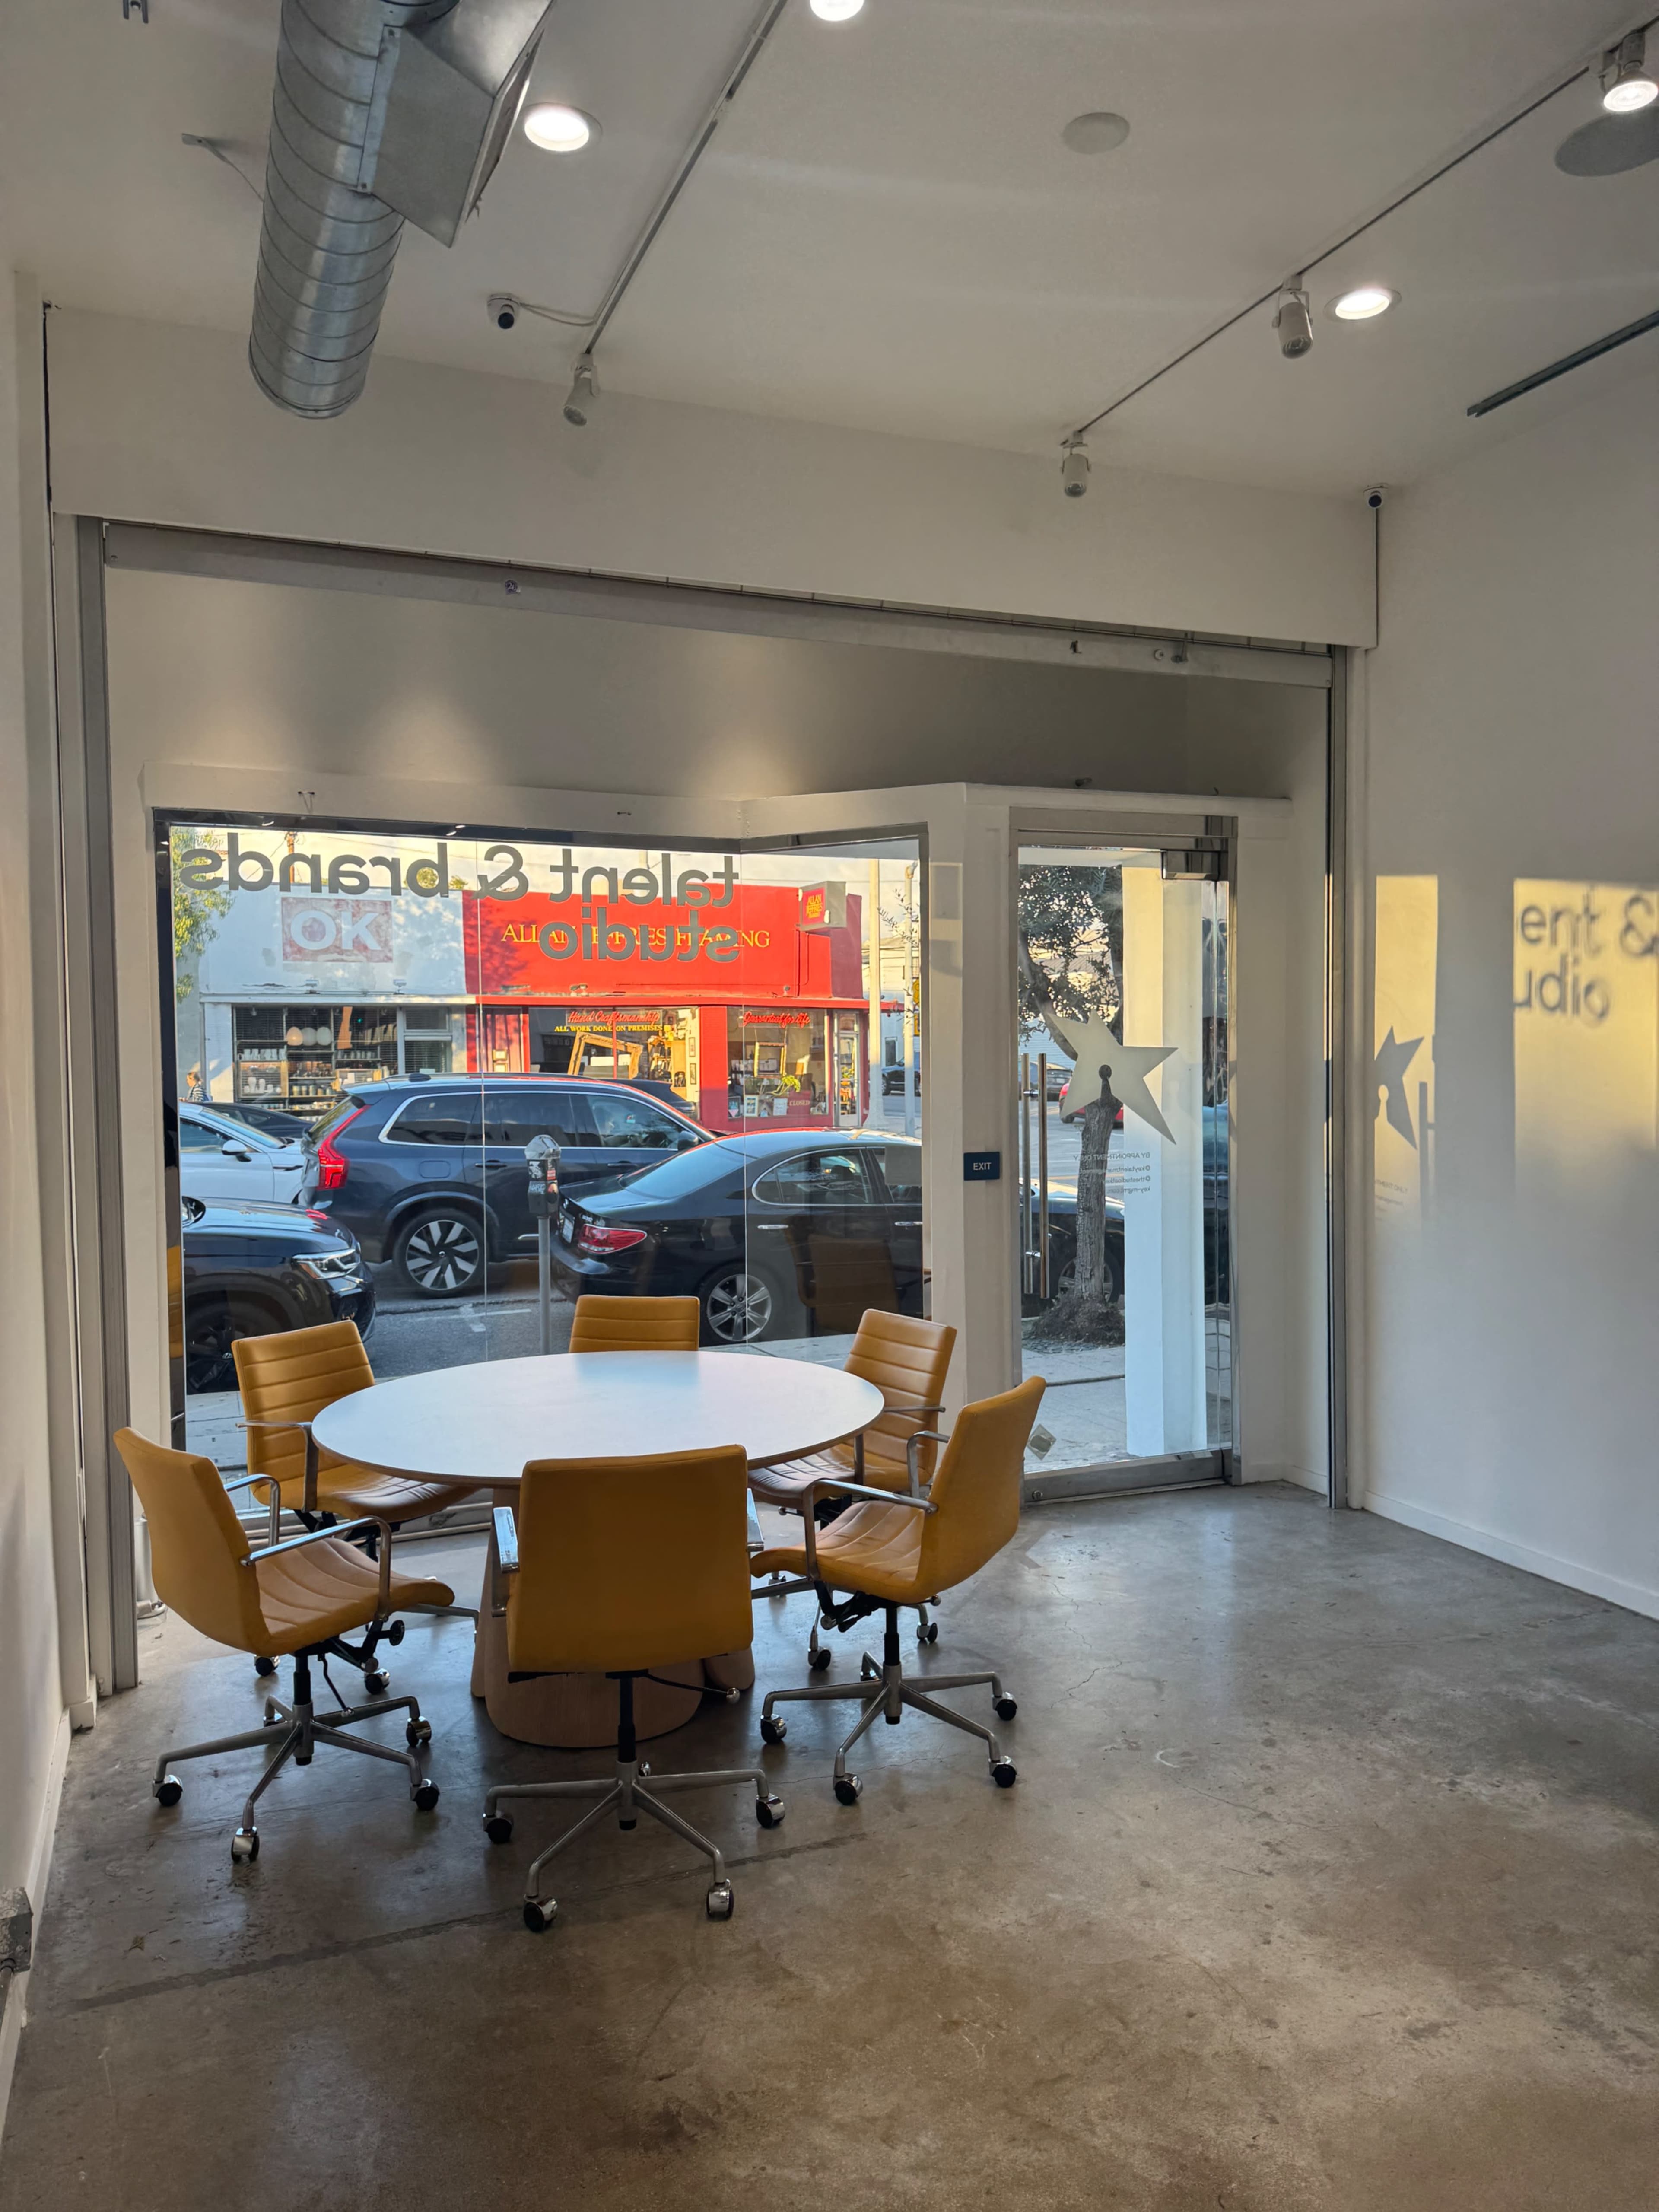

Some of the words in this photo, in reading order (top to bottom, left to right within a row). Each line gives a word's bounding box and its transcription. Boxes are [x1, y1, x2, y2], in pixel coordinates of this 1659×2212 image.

[290, 909, 382, 950] OK
[583, 926, 666, 945] EFRES
[676, 929, 770, 948] FAMNG
[568, 1011, 594, 1023] Hand
[973, 1162, 992, 1170] EXIT
